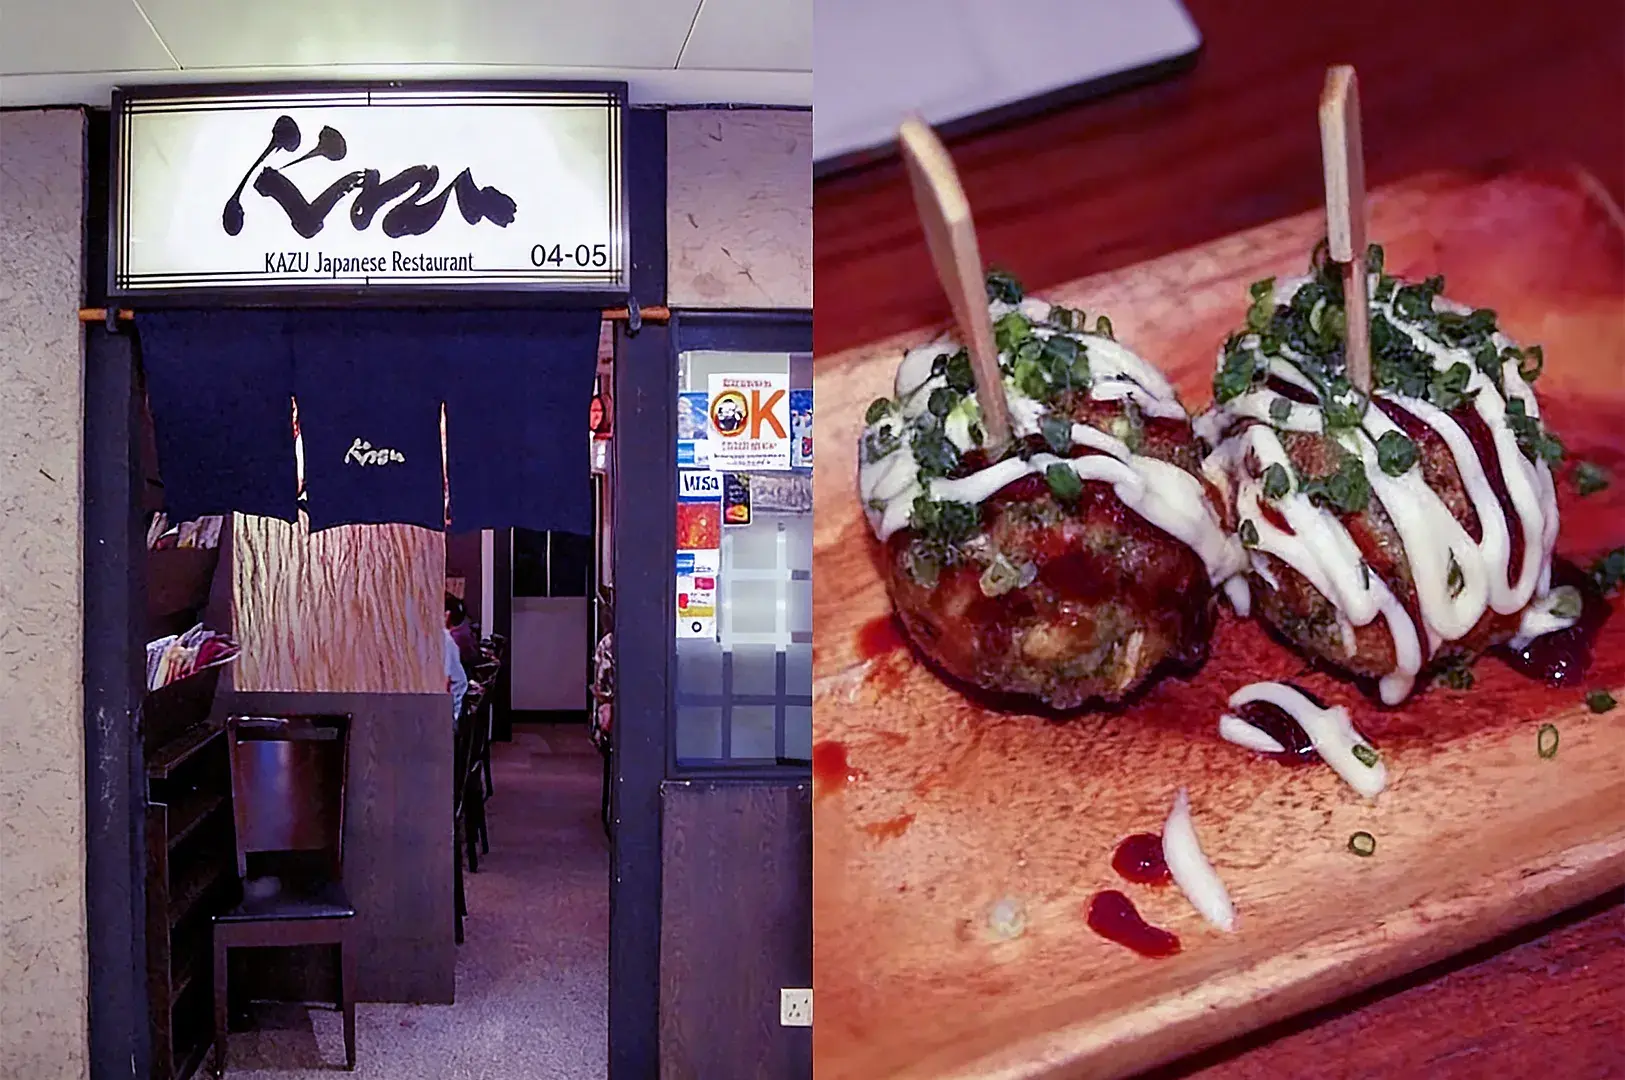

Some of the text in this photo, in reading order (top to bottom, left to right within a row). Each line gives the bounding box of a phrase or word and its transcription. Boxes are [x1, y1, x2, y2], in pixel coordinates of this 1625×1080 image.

[265, 251, 475, 279] KAZU Japanese Restaurant
[531, 244, 607, 267] 04-05
[710, 388, 788, 440] OK
